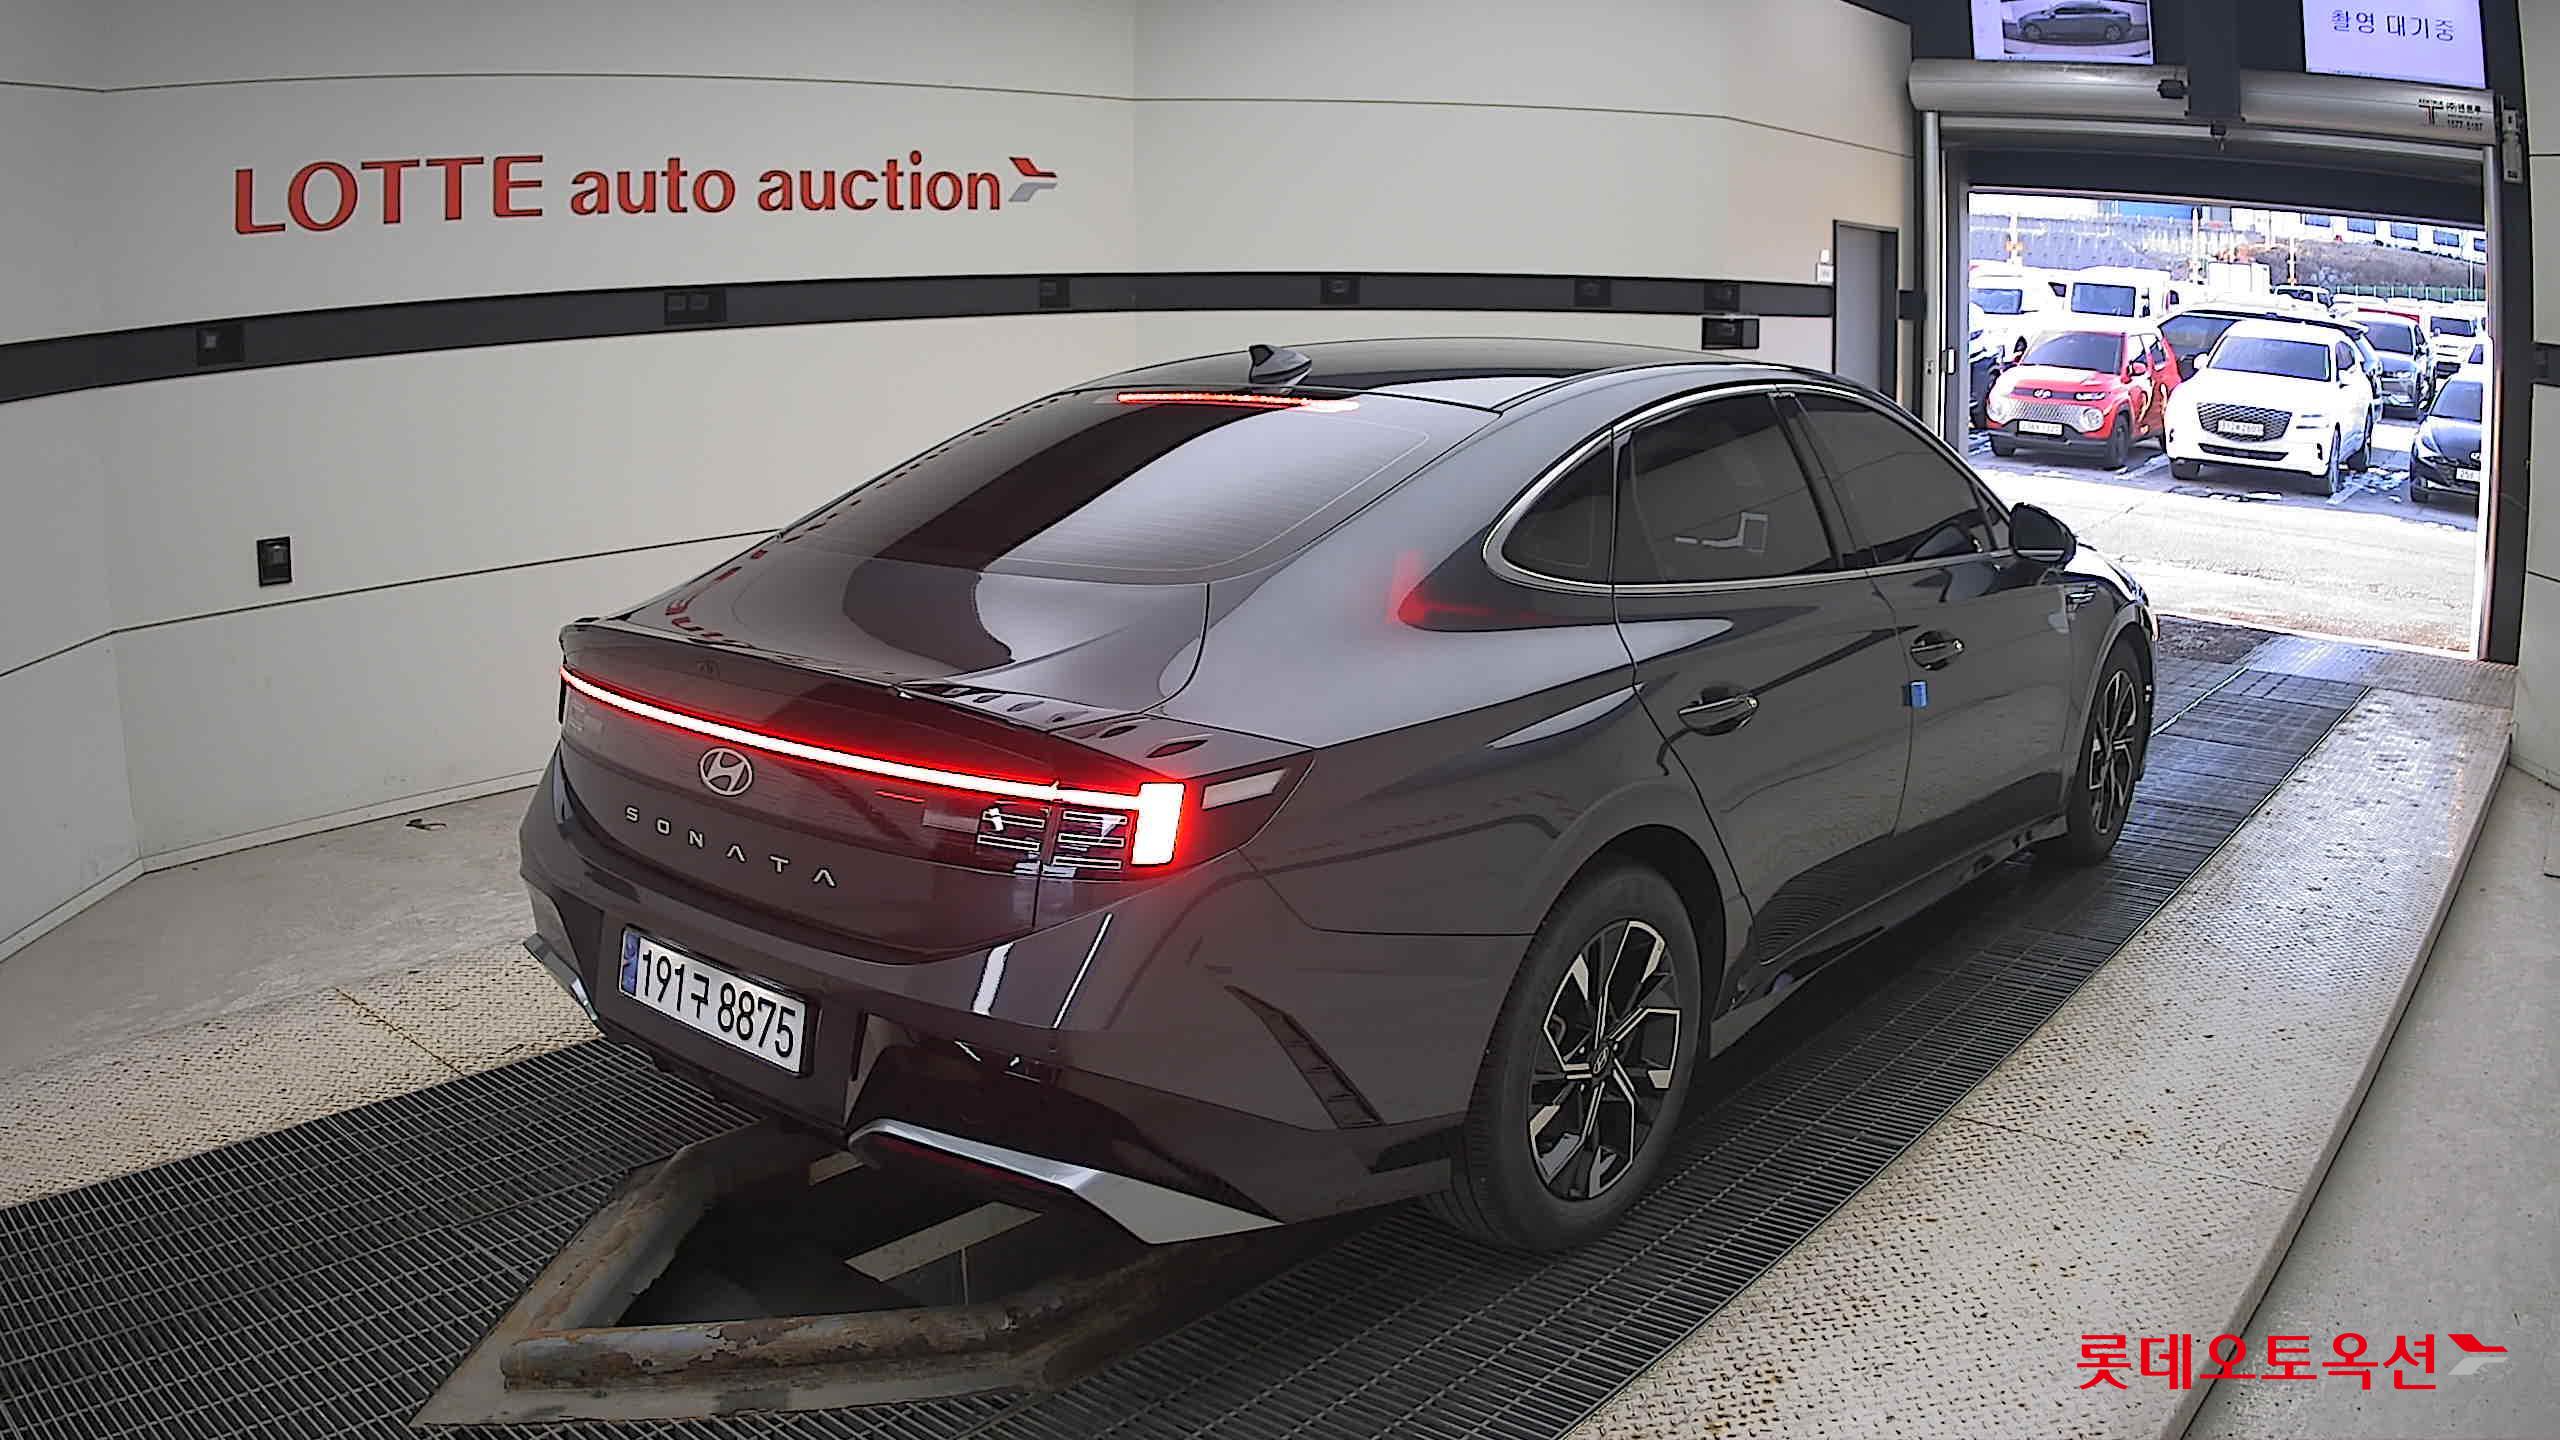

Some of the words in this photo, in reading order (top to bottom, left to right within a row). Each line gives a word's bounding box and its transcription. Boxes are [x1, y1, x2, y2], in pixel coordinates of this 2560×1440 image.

[2331, 10, 2375, 34] 촬영
[2386, 15, 2455, 42] 대기중
[235, 155, 543, 235] LOTTE
[571, 158, 737, 215] auto
[758, 150, 1002, 212] auction
[625, 806, 838, 888] SONATA
[643, 949, 710, 1019] 191구
[718, 982, 796, 1058] 8875
